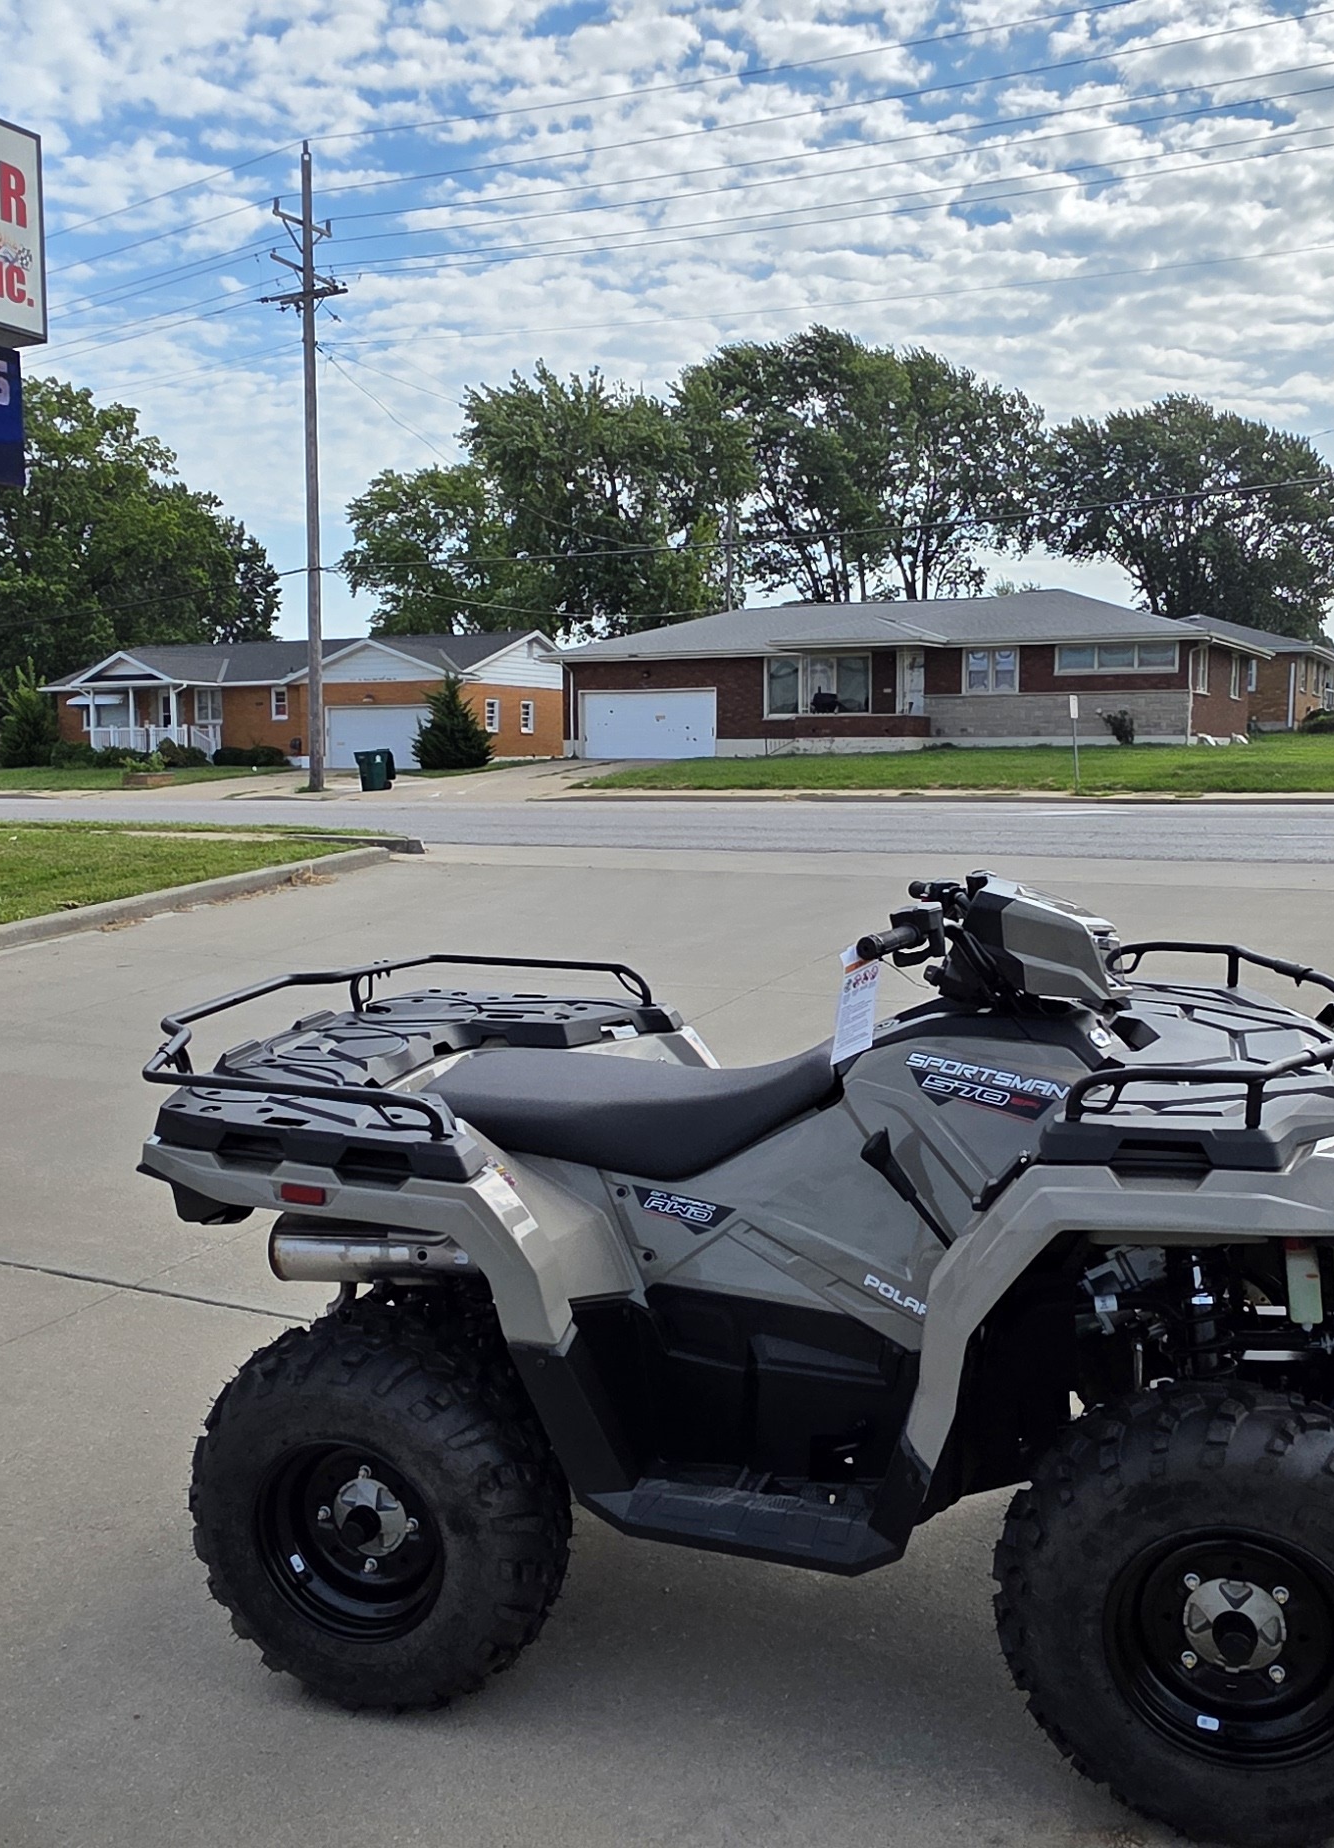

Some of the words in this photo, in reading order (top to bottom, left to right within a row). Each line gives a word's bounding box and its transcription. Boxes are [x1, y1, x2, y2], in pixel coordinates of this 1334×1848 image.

[905, 1052, 1071, 1100] SPORTSMAN
[921, 1074, 1011, 1107] 570
[643, 1196, 713, 1222] AWD
[863, 1273, 928, 1316] POLAR
